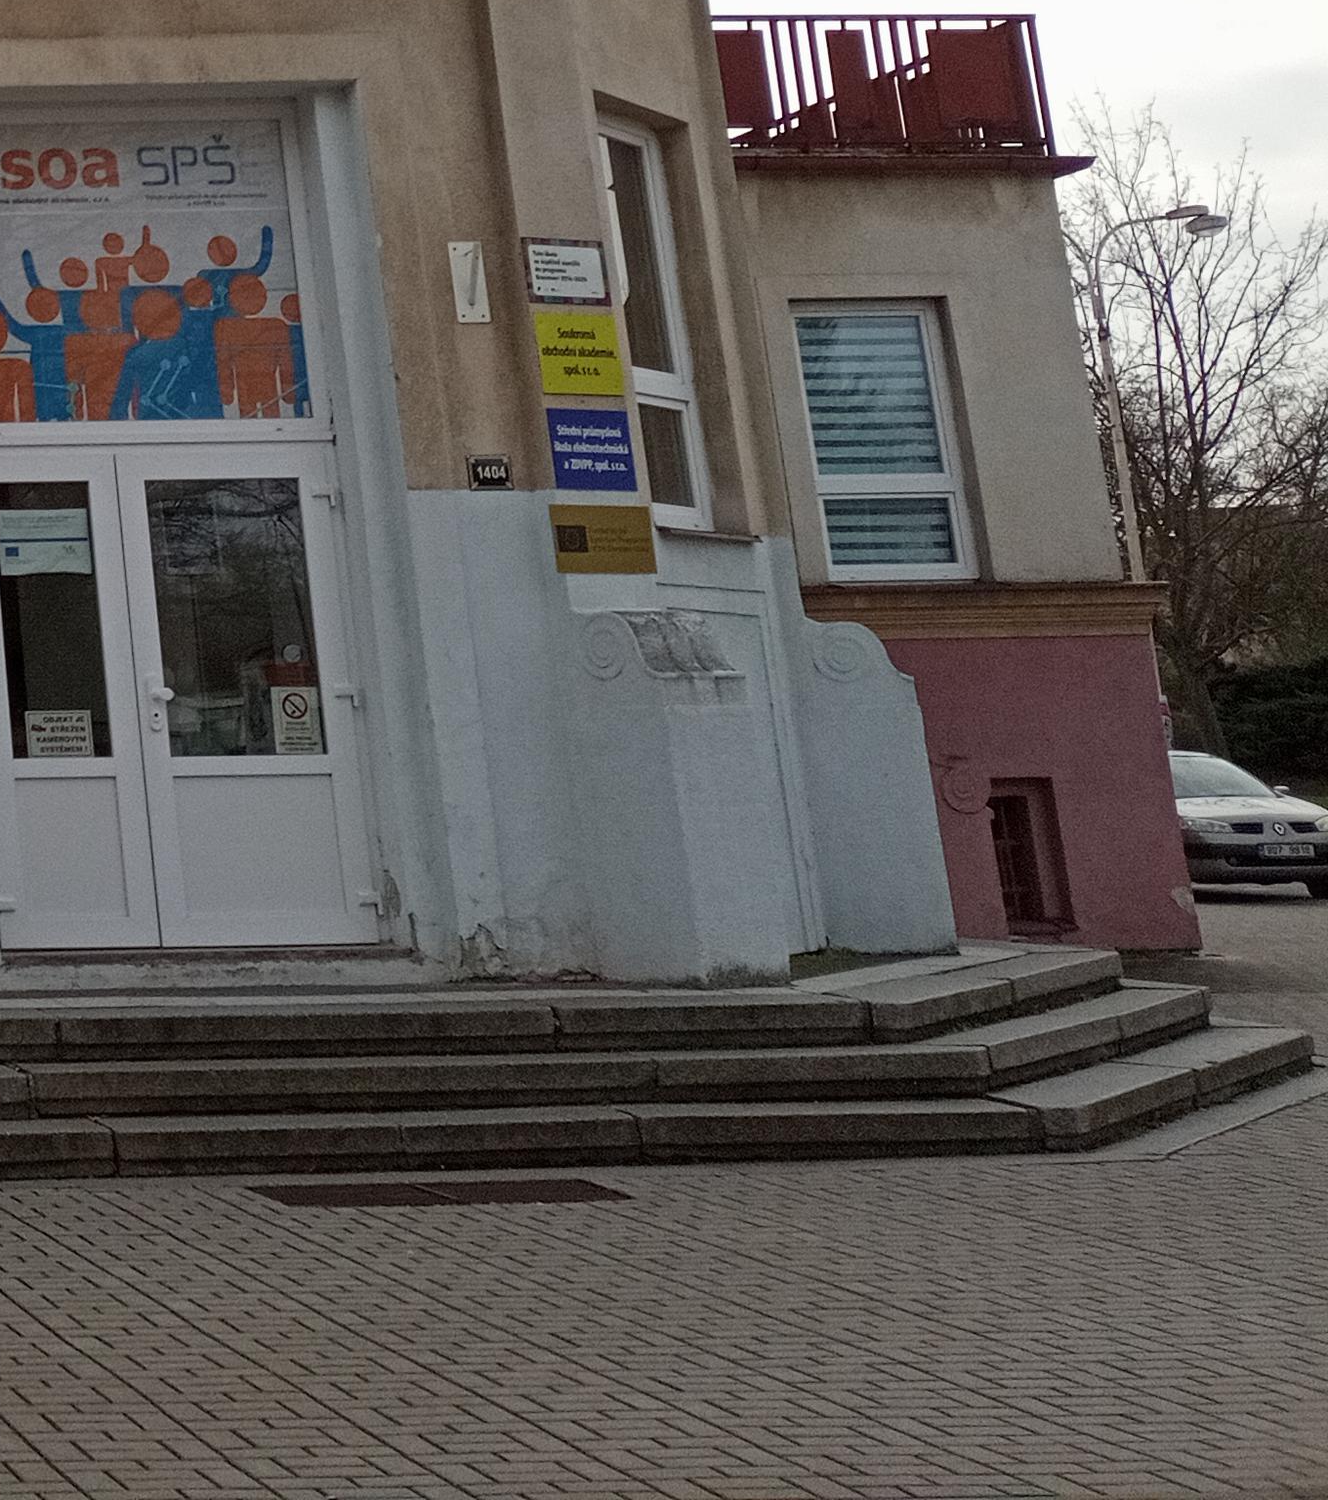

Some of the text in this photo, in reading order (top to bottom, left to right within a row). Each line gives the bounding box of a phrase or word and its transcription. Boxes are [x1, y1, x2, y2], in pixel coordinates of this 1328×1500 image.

[0, 147, 120, 190] soa
[136, 133, 236, 186] SPŠ
[476, 465, 507, 479] 1404
